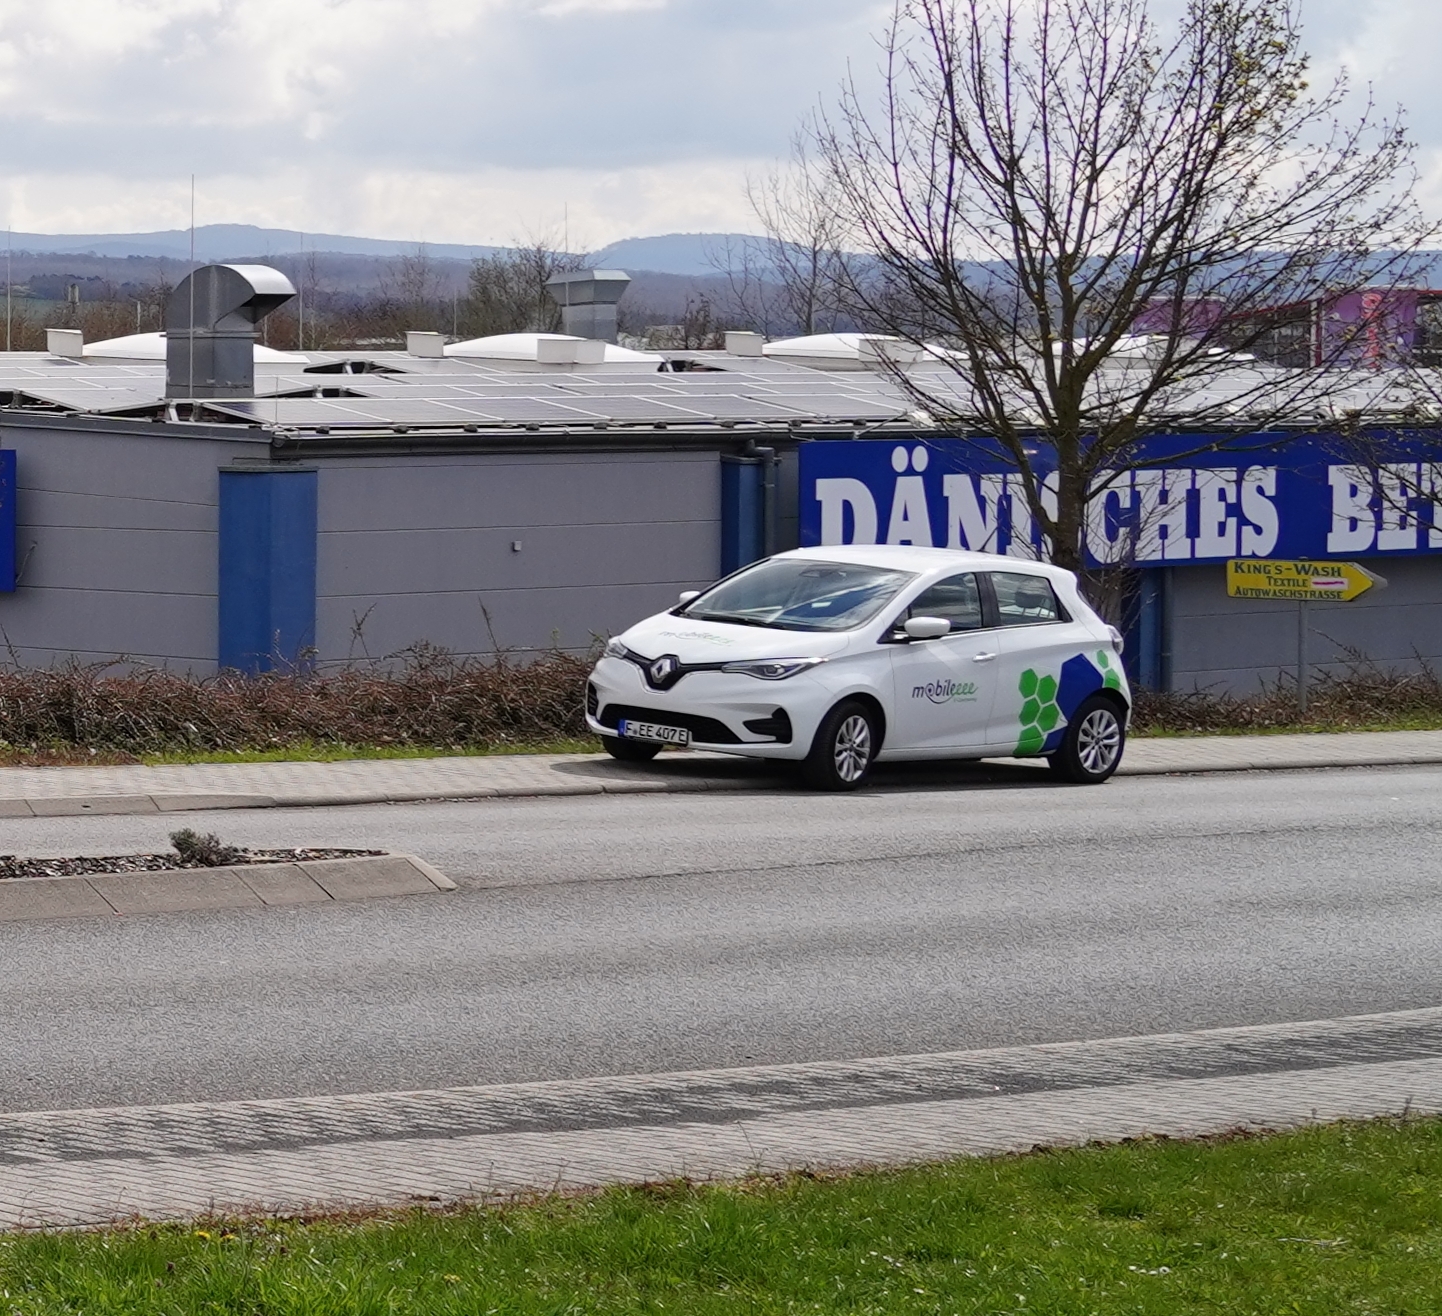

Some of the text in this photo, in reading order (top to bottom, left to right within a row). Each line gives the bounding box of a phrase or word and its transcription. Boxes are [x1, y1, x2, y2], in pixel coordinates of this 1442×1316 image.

[815, 445, 1278, 564] DÄNICHES
[1266, 576, 1308, 588] TEXTILE
[1234, 586, 1344, 600] AUTOWASCHSTRASSE
